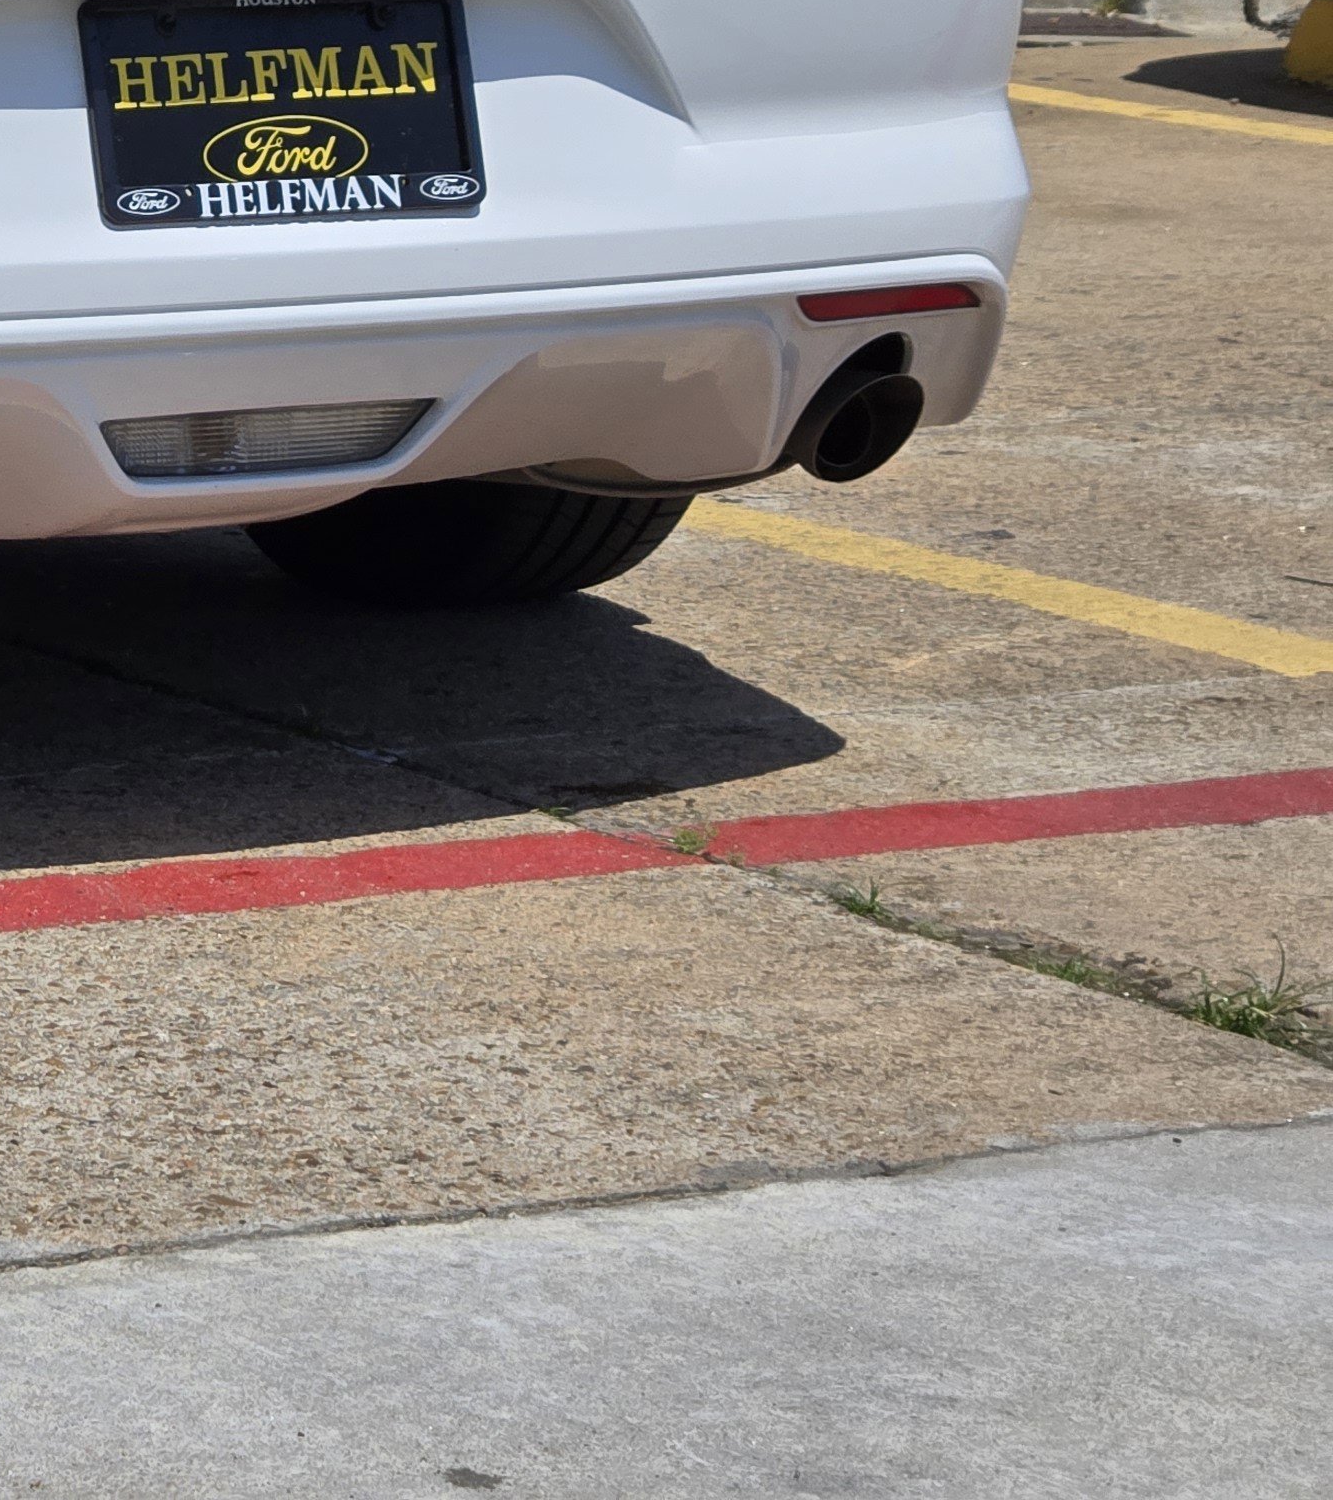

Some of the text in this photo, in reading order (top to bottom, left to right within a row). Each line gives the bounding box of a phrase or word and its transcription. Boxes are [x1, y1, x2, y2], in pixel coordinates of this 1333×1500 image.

[109, 41, 438, 110] HELFMAN
[236, 125, 338, 176] Ford
[127, 173, 470, 219] Ford HELFMAN Ford
